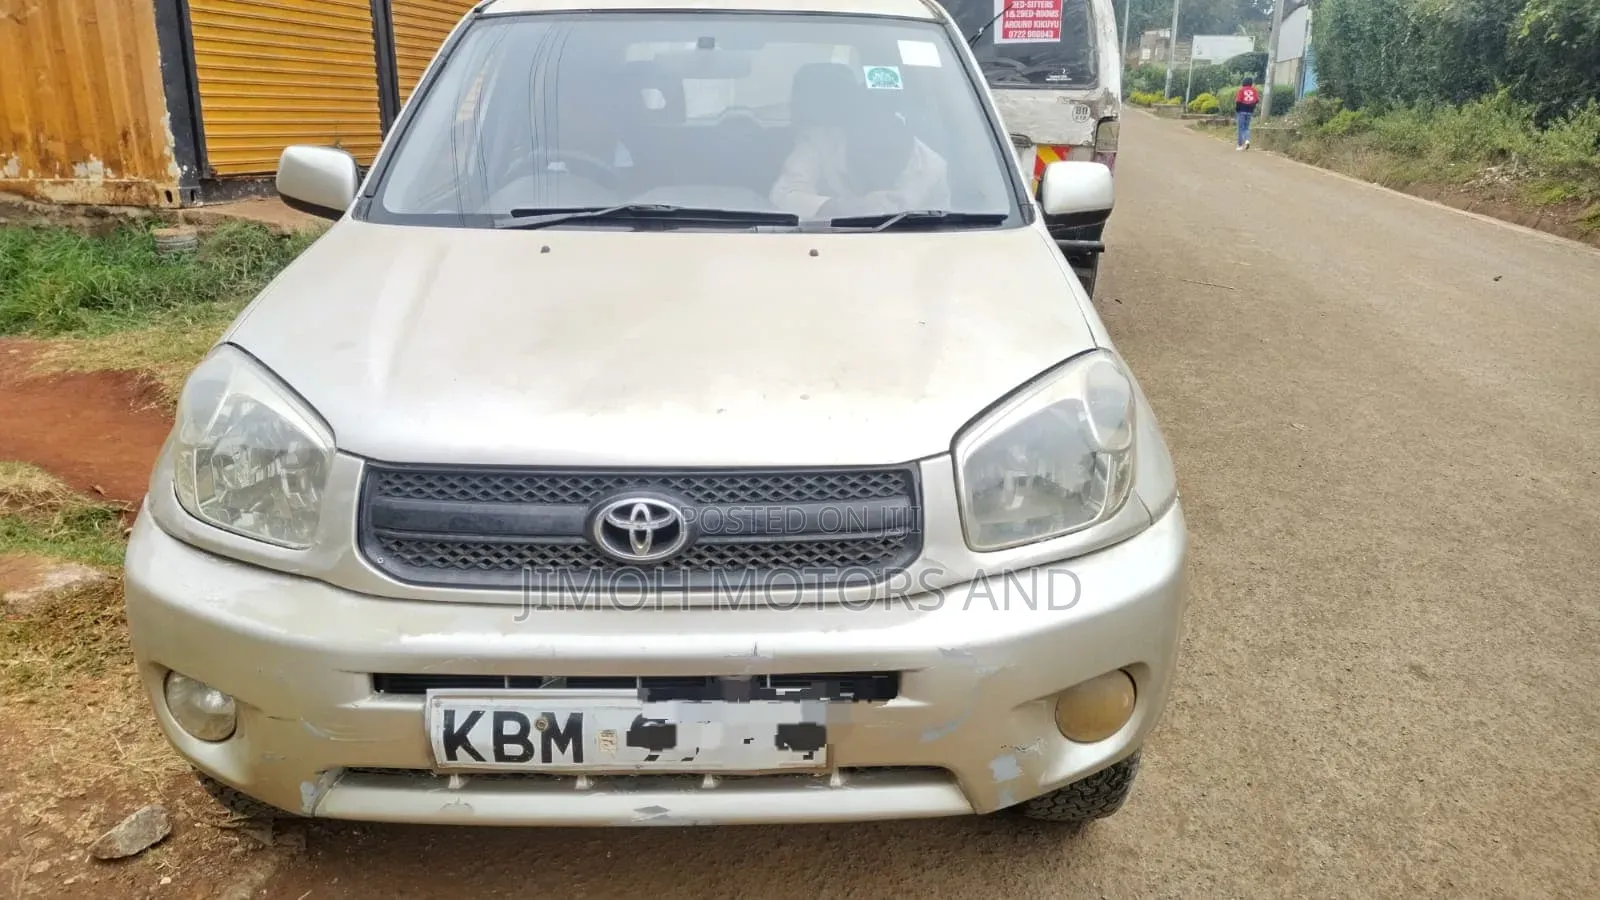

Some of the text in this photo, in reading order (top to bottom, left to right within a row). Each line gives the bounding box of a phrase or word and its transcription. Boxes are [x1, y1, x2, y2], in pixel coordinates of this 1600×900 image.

[1004, 20, 1033, 29] AROUND
[1008, 30, 1027, 39] 0722
[443, 709, 584, 764] KBM
